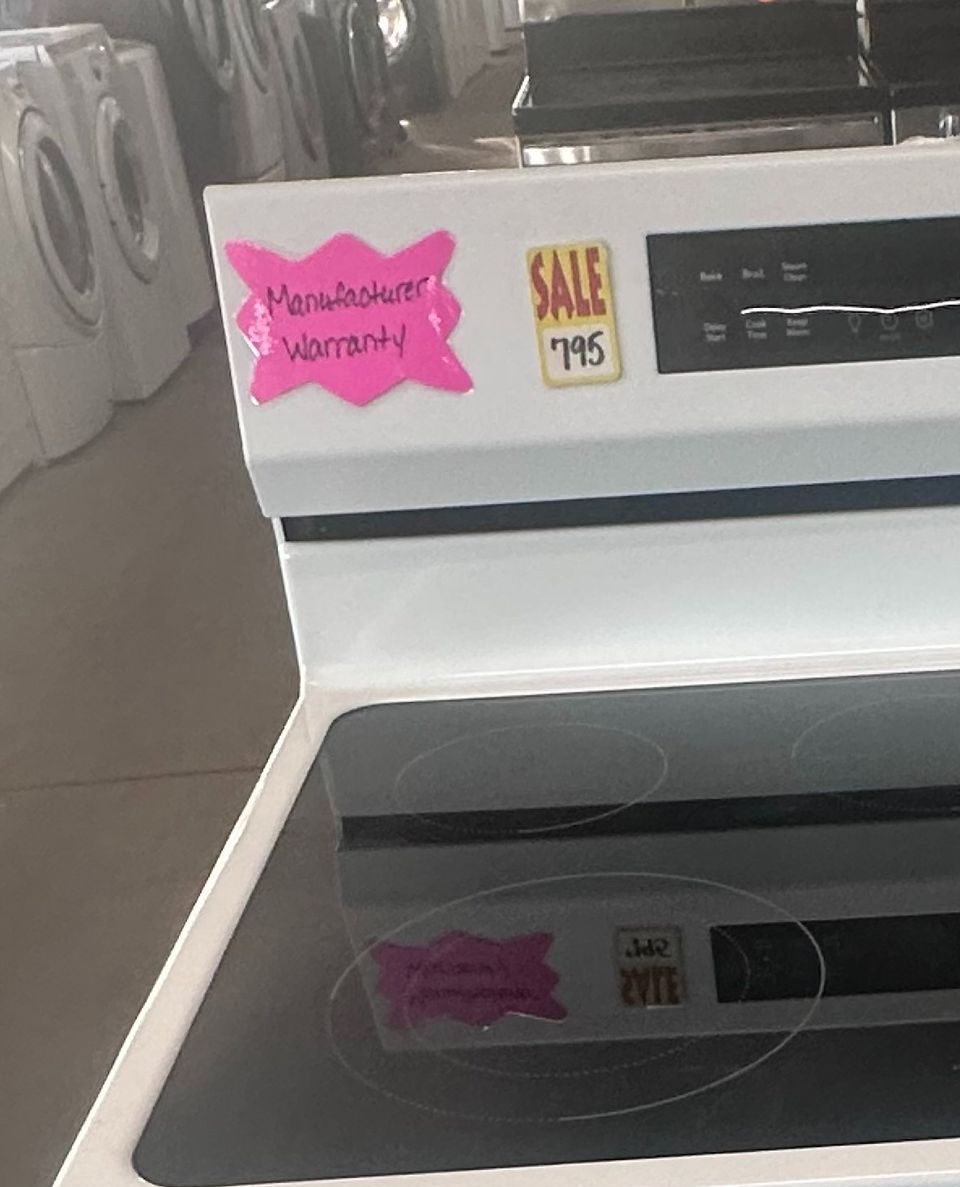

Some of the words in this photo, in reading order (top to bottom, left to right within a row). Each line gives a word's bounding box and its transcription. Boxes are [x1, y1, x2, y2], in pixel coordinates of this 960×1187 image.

[265, 275, 431, 318] Manufacturer
[529, 246, 608, 320] SALE
[283, 323, 407, 362] Warranty
[550, 331, 606, 372] 795
